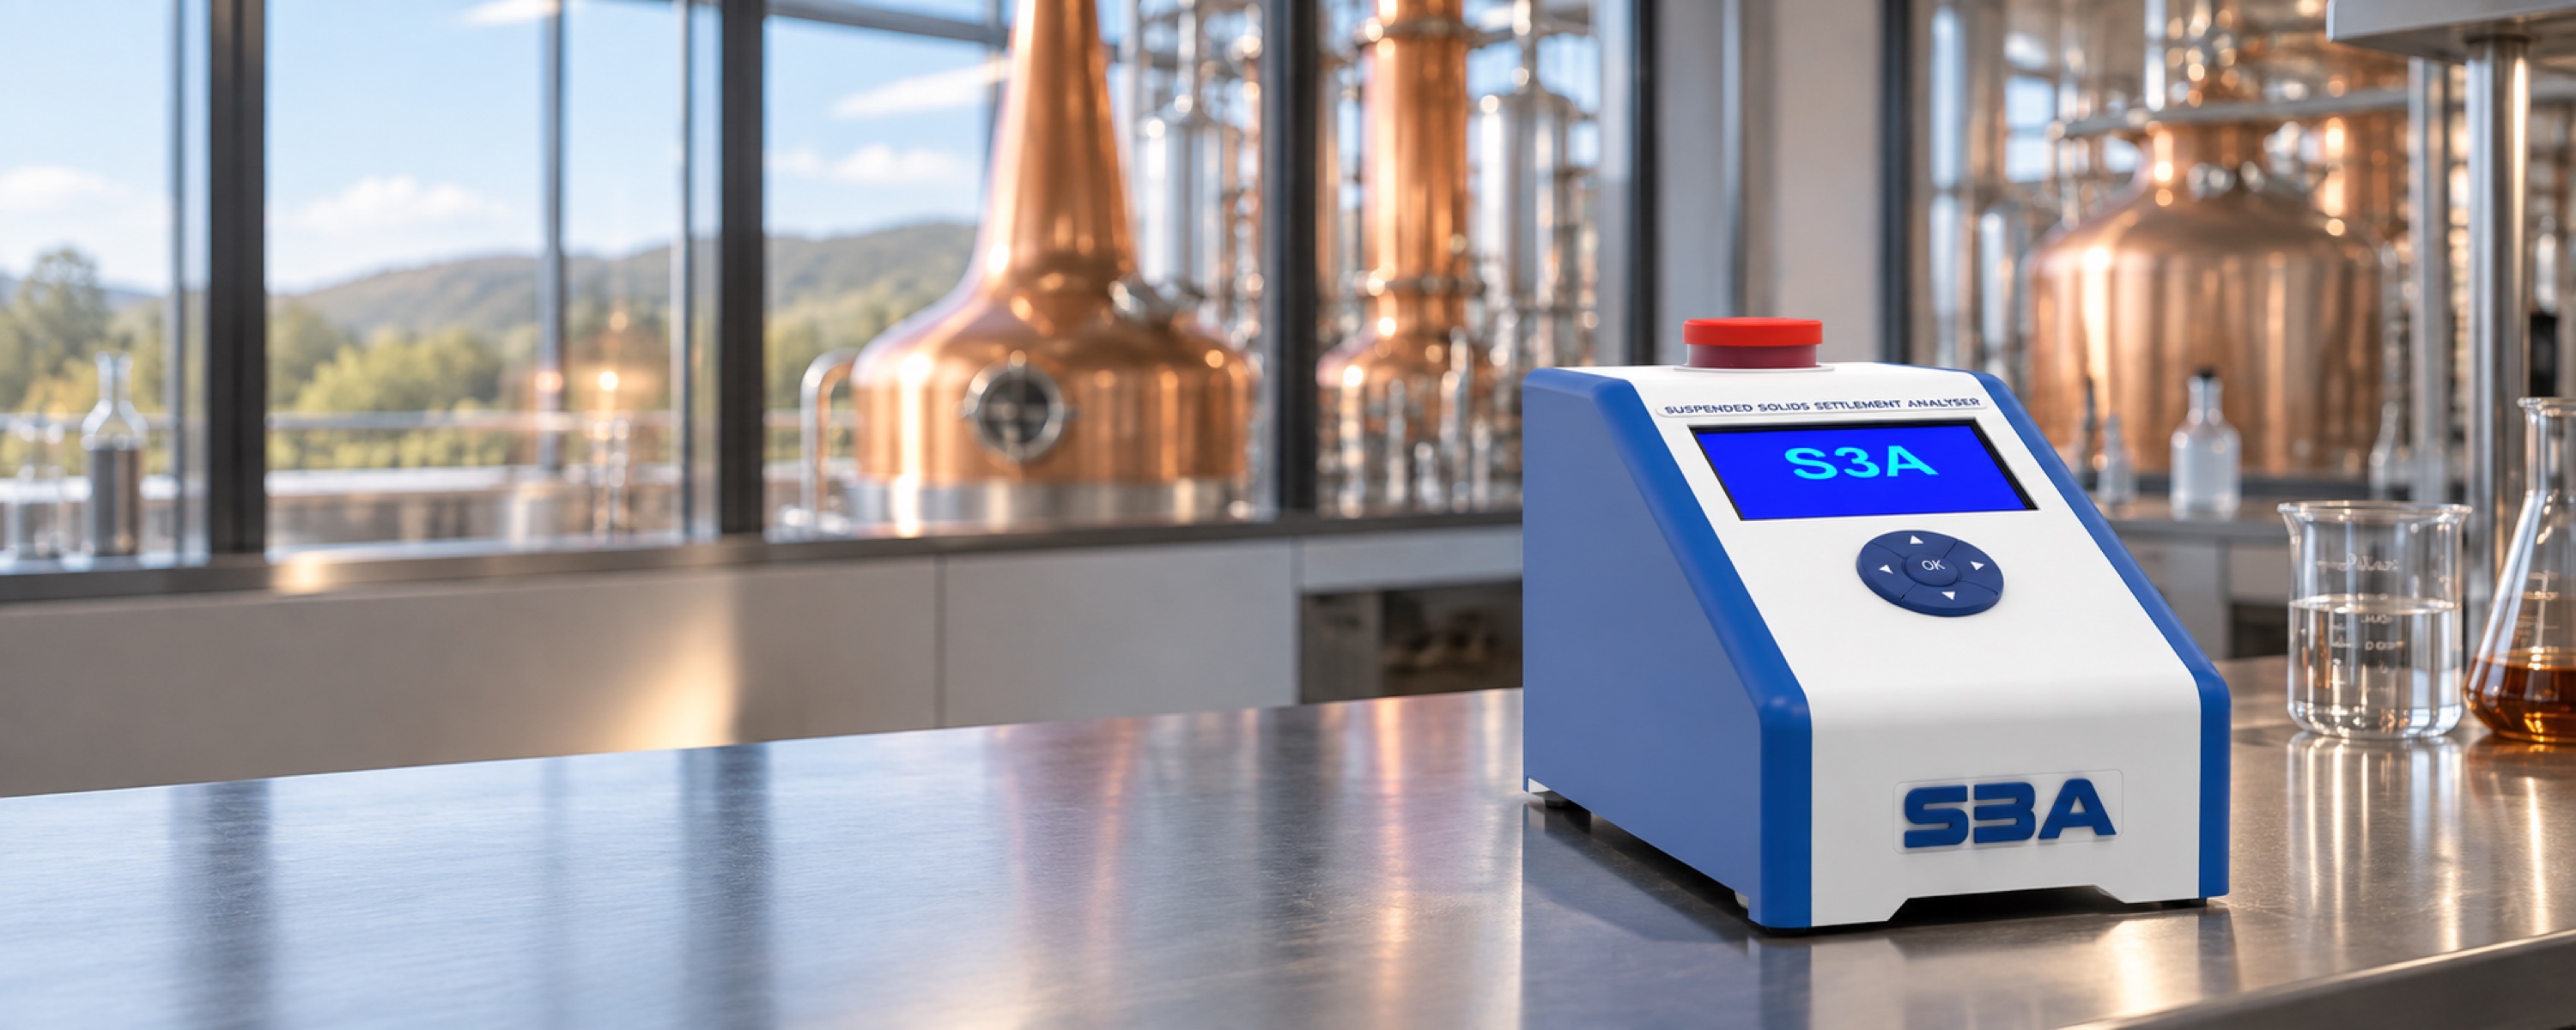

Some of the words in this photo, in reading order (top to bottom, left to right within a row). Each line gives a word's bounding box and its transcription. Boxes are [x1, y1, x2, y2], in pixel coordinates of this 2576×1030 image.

[1664, 403, 1753, 415] SUSPENDED
[1757, 402, 1810, 413] SOLIDS
[1814, 400, 1901, 411] SETTLEMENT
[1907, 397, 1981, 408] ANALYSER
[1784, 445, 1939, 480] S3A
[1921, 559, 1946, 572] OK
